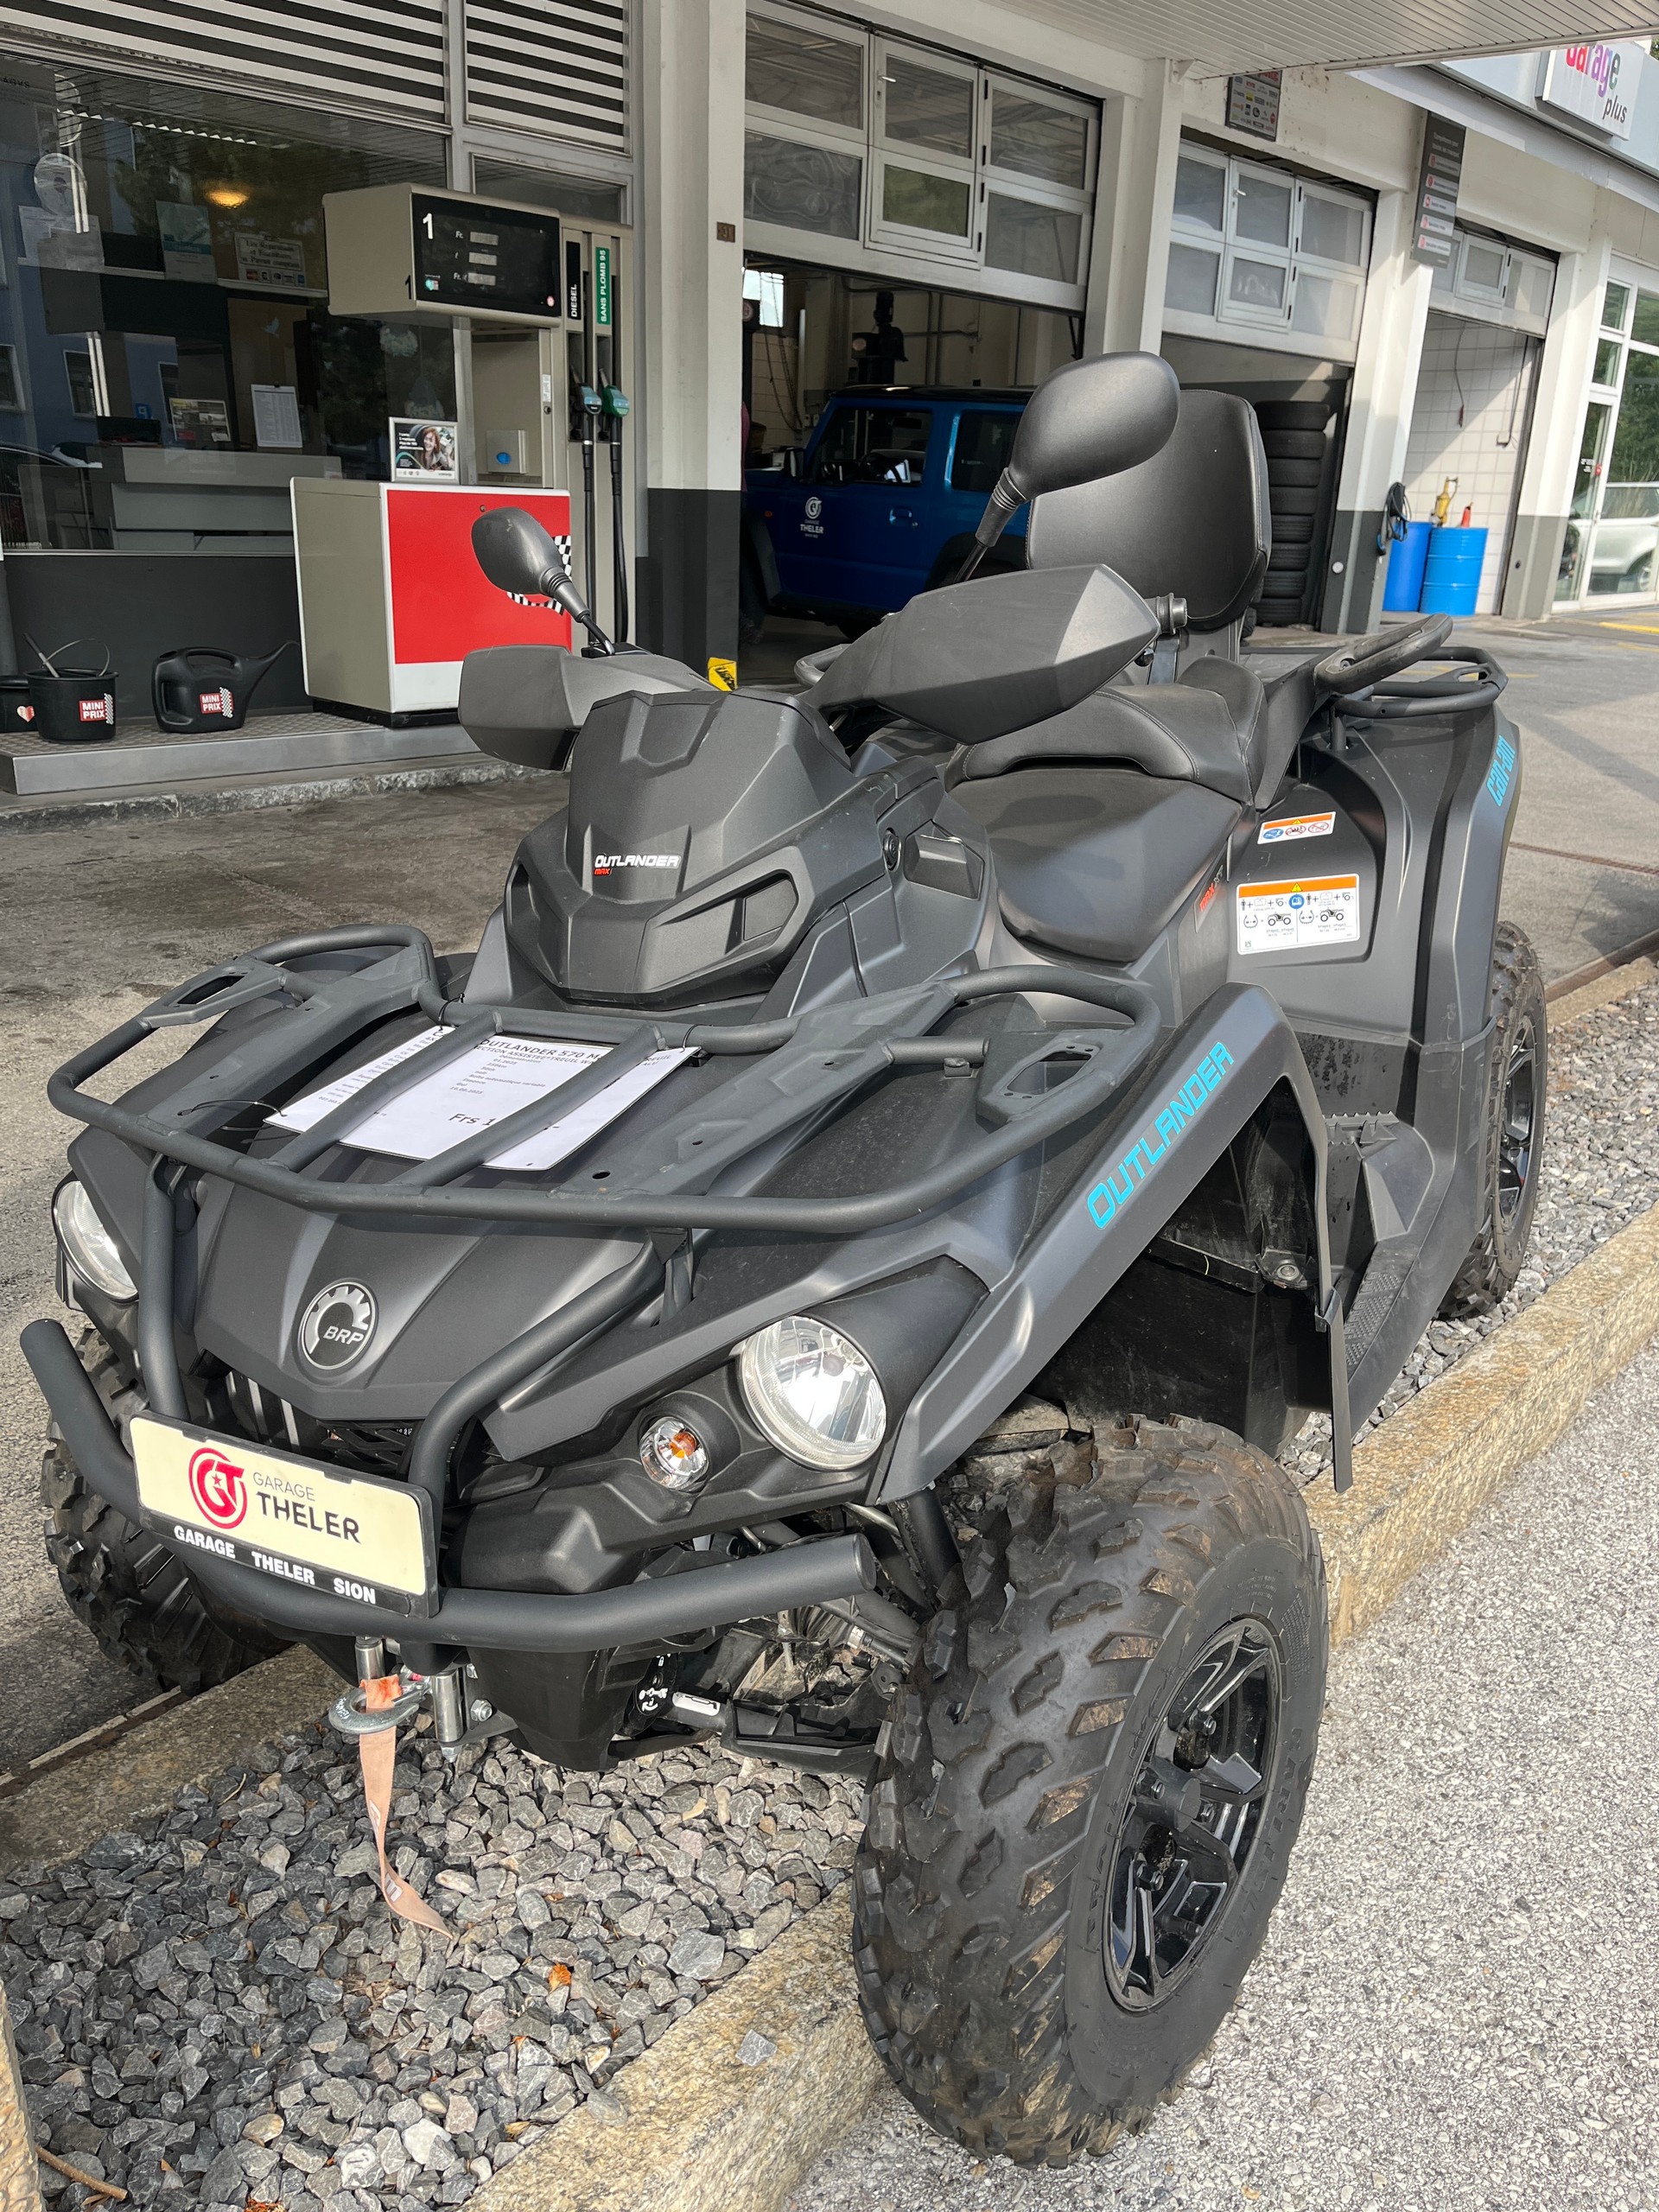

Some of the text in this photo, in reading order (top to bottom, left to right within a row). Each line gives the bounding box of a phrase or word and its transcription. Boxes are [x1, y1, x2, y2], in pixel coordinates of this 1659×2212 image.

[1602, 95, 1628, 124] plus
[423, 213, 434, 240] 1
[598, 250, 607, 259] 95
[404, 275, 412, 300] 1
[599, 261, 607, 296] PLOMB
[570, 283, 579, 318] DIESEL
[799, 524, 824, 534] THELER
[82, 701, 105, 711] MINI
[201, 695, 220, 704] MINI
[202, 702, 222, 713] PRIX
[82, 710, 105, 721] PRIX
[594, 855, 681, 868] OUTLANDER
[480, 1039, 554, 1056] OUTLANDER
[558, 1050, 583, 1058] 570
[448, 1113, 480, 1125] Frs
[1086, 1041, 1235, 1230] OUTLANDER
[322, 1325, 365, 1345] BRP
[252, 1471, 316, 1502] GARAGE
[256, 1491, 362, 1545] THELER
[174, 1524, 377, 1605] GARAGE THELER SION
